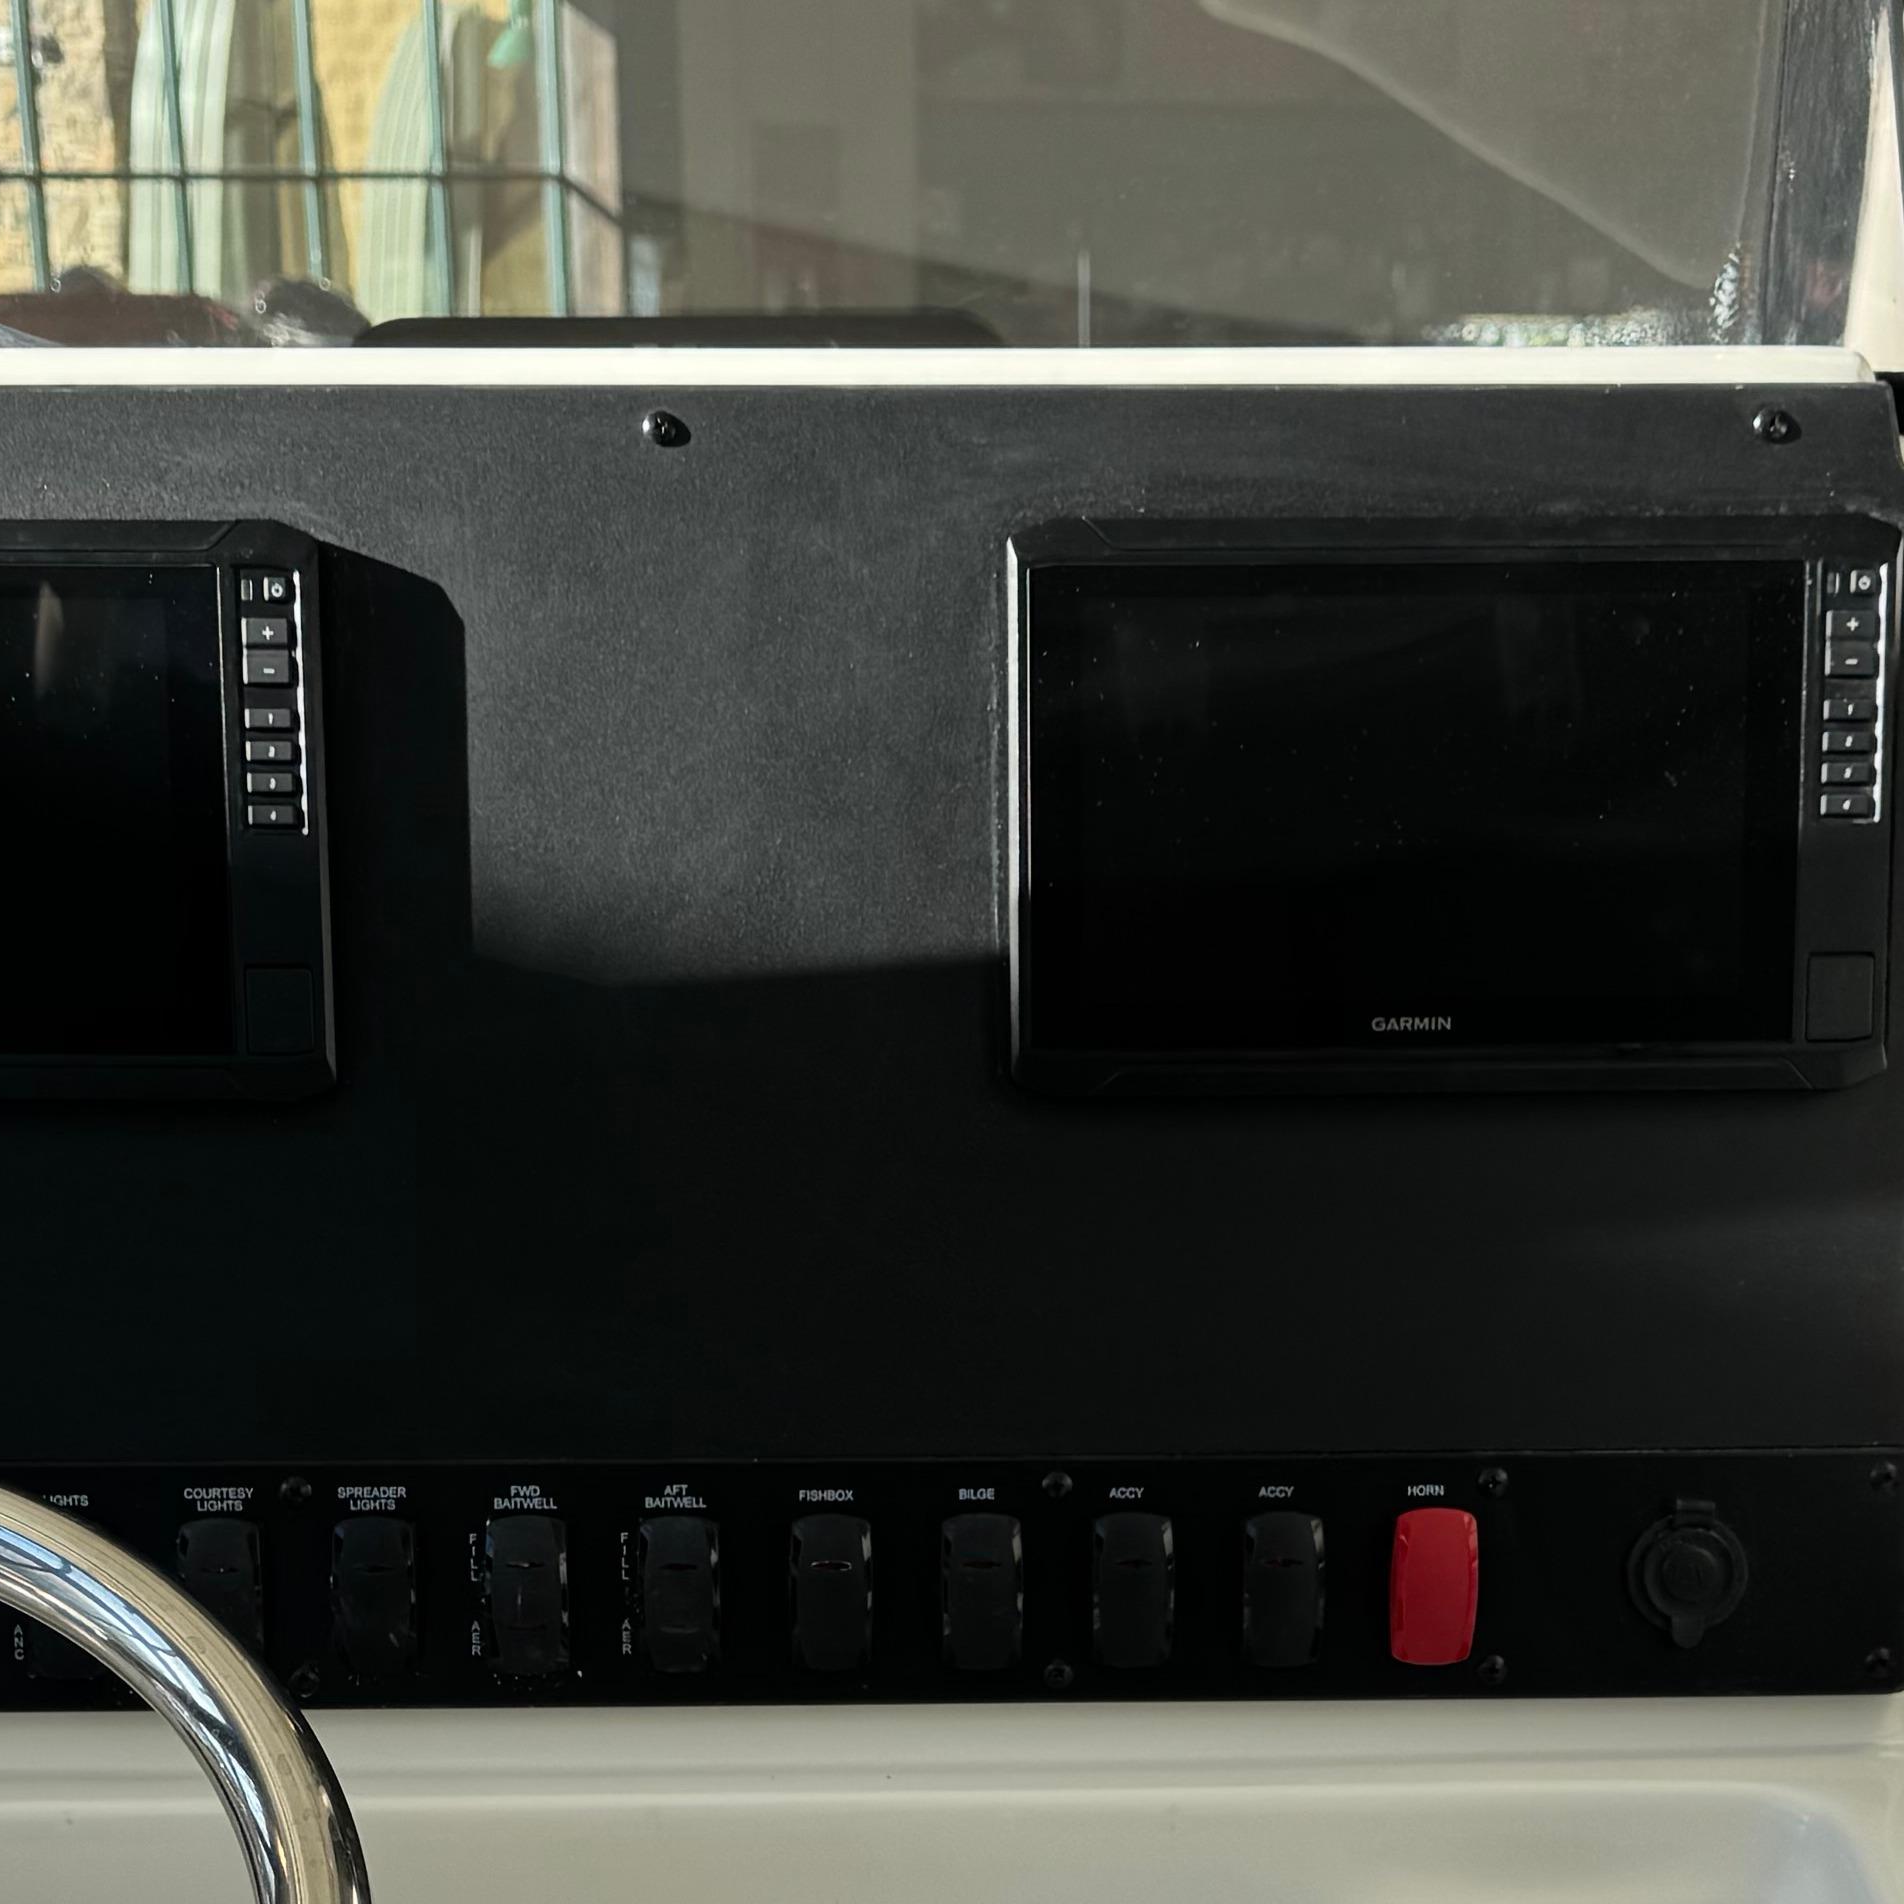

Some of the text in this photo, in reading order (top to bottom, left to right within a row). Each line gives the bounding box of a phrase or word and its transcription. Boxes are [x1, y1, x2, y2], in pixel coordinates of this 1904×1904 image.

[1371, 1015, 1452, 1032] GARMIN
[183, 1487, 254, 1499] COURTESY
[337, 1486, 407, 1499] SPREADER
[510, 1485, 540, 1498] FWD
[664, 1484, 689, 1496] AFT
[798, 1489, 854, 1502] FISHBOX
[958, 1488, 995, 1501] BILGE
[1109, 1487, 1144, 1499] ACCY
[1258, 1486, 1294, 1498] ACCY
[1407, 1485, 1444, 1497] HORN
[196, 1500, 243, 1512] LIGHTS
[349, 1499, 396, 1511] LIGHTS
[493, 1497, 557, 1510] BAITWELL
[644, 1496, 707, 1509] BAITWELL
